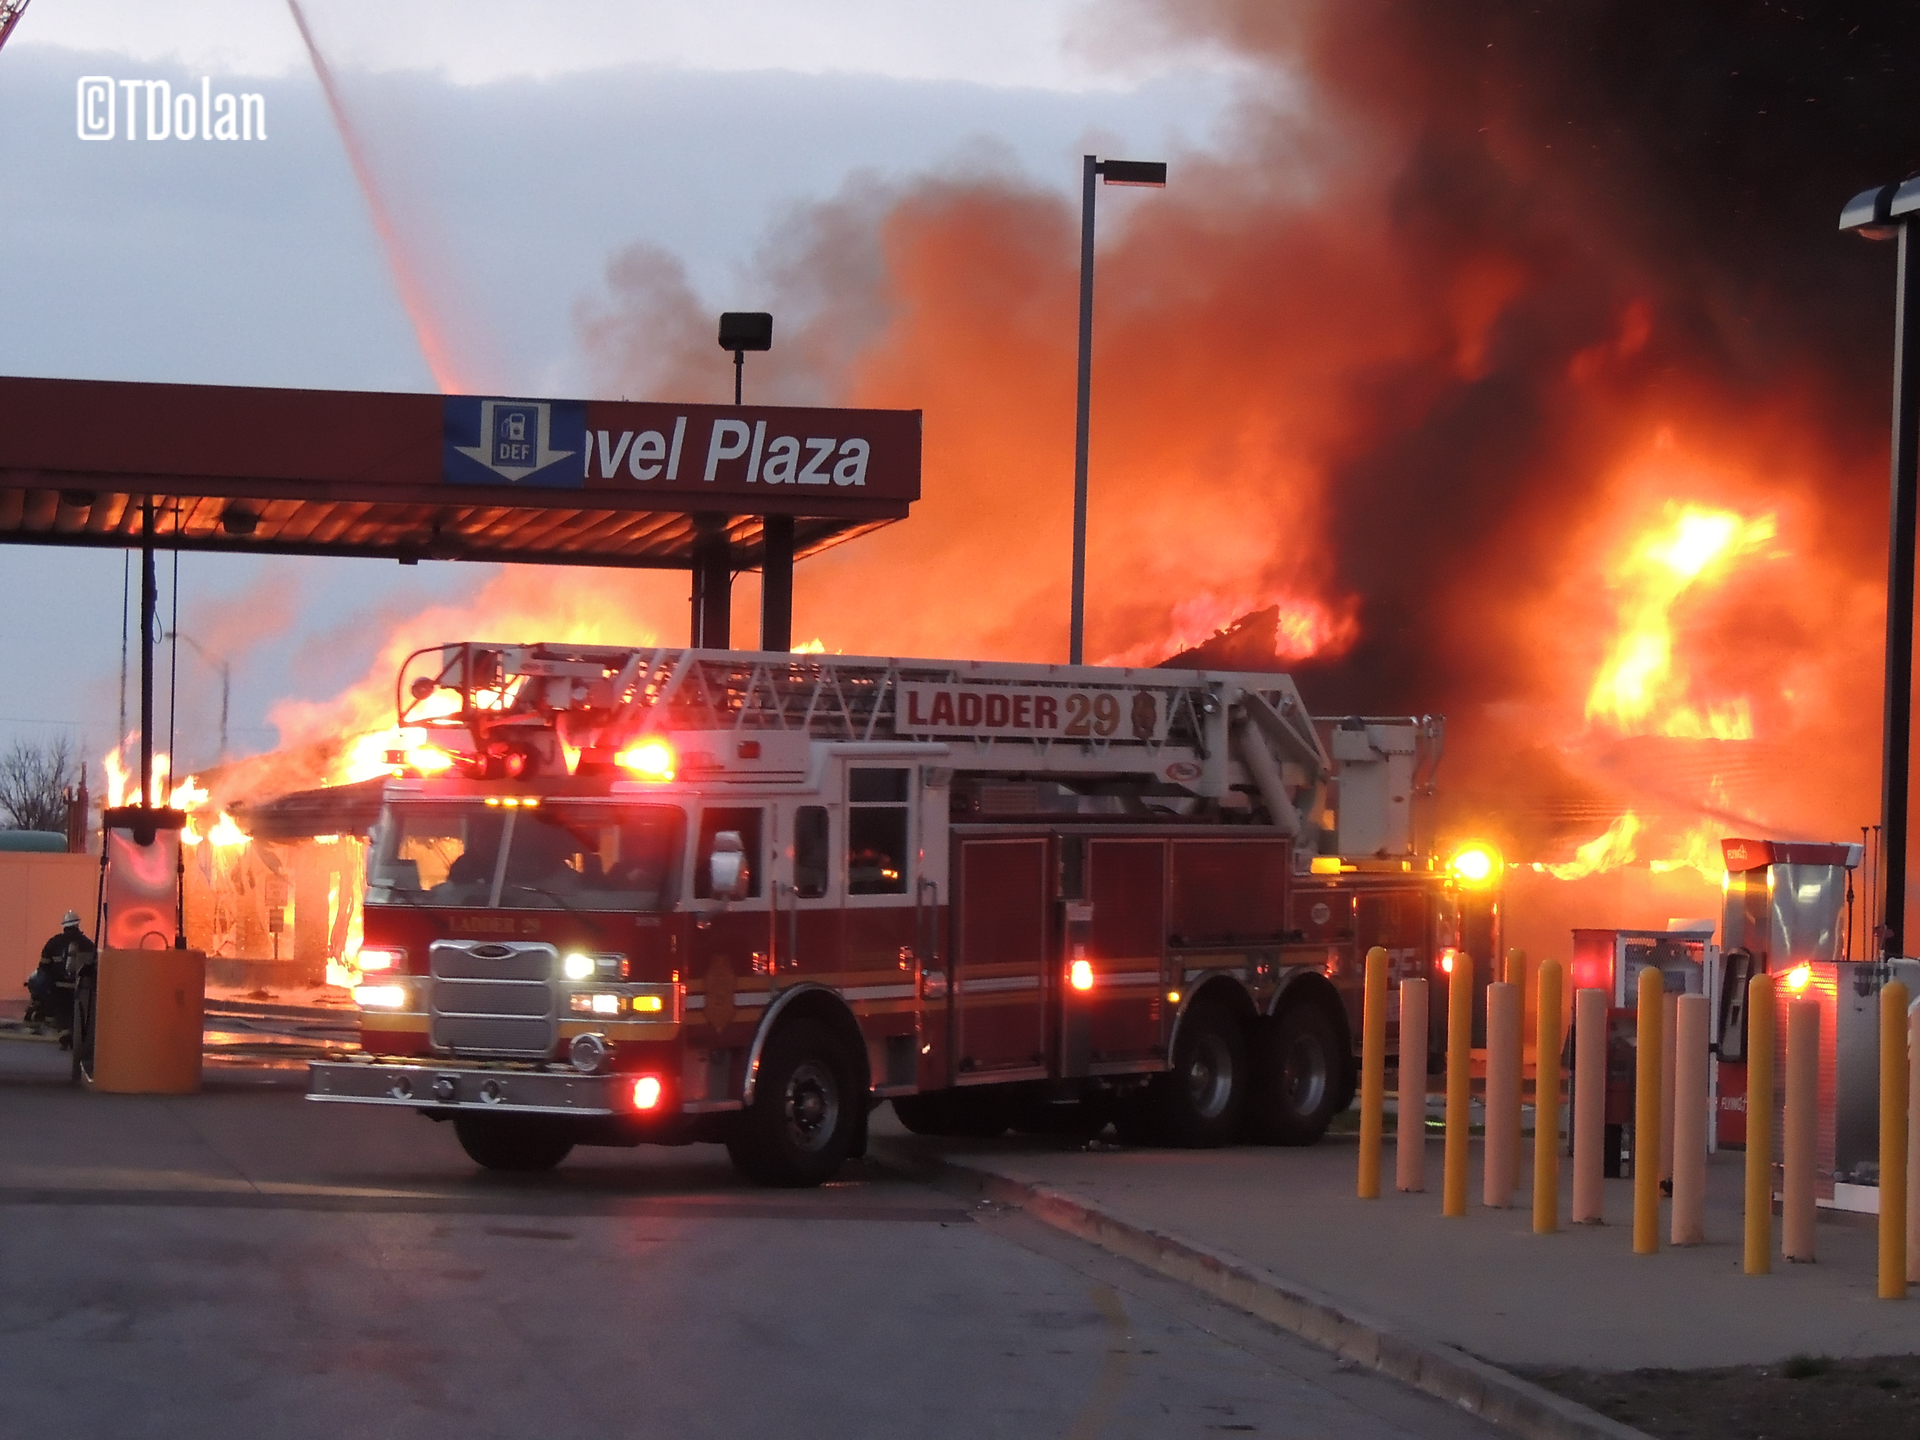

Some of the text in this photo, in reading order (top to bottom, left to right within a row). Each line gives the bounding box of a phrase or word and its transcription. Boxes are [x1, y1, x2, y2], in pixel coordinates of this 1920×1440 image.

[500, 443, 530, 460] DEF
[704, 419, 871, 486] Plaza
[907, 690, 1121, 736] LADDER 29
[449, 916, 515, 933] LADDER
[1721, 1096, 1742, 1111] FLYING
